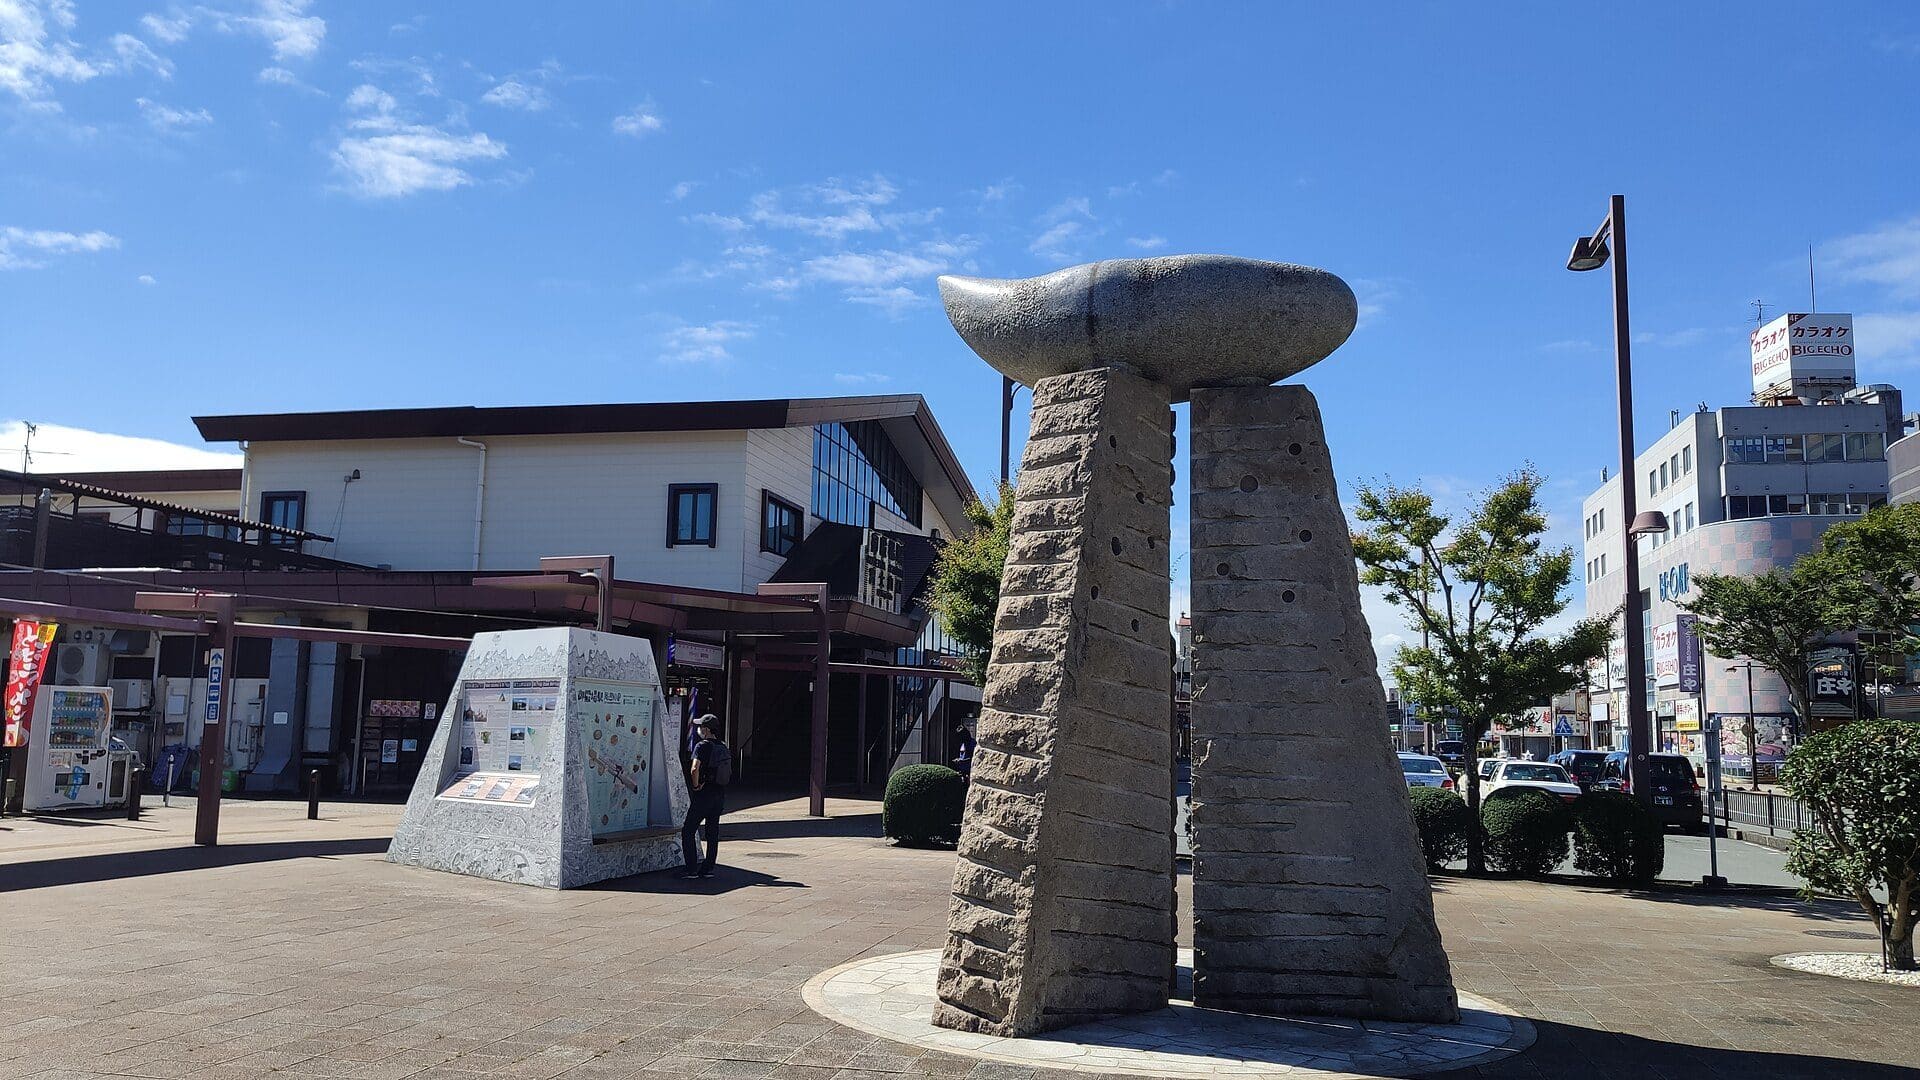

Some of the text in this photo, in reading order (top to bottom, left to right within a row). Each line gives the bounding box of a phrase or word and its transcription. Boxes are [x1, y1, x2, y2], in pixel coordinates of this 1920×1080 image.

[1754, 327, 1787, 354] カラオケ
[1792, 326, 1850, 338] カラオケ
[1791, 344, 1853, 356] BIG ECHO
[1753, 348, 1789, 376] BIG ECHO
[1655, 630, 1677, 651] カラオケ
[1682, 663, 1698, 691] 庄や
[1817, 677, 1856, 696] 庄や
